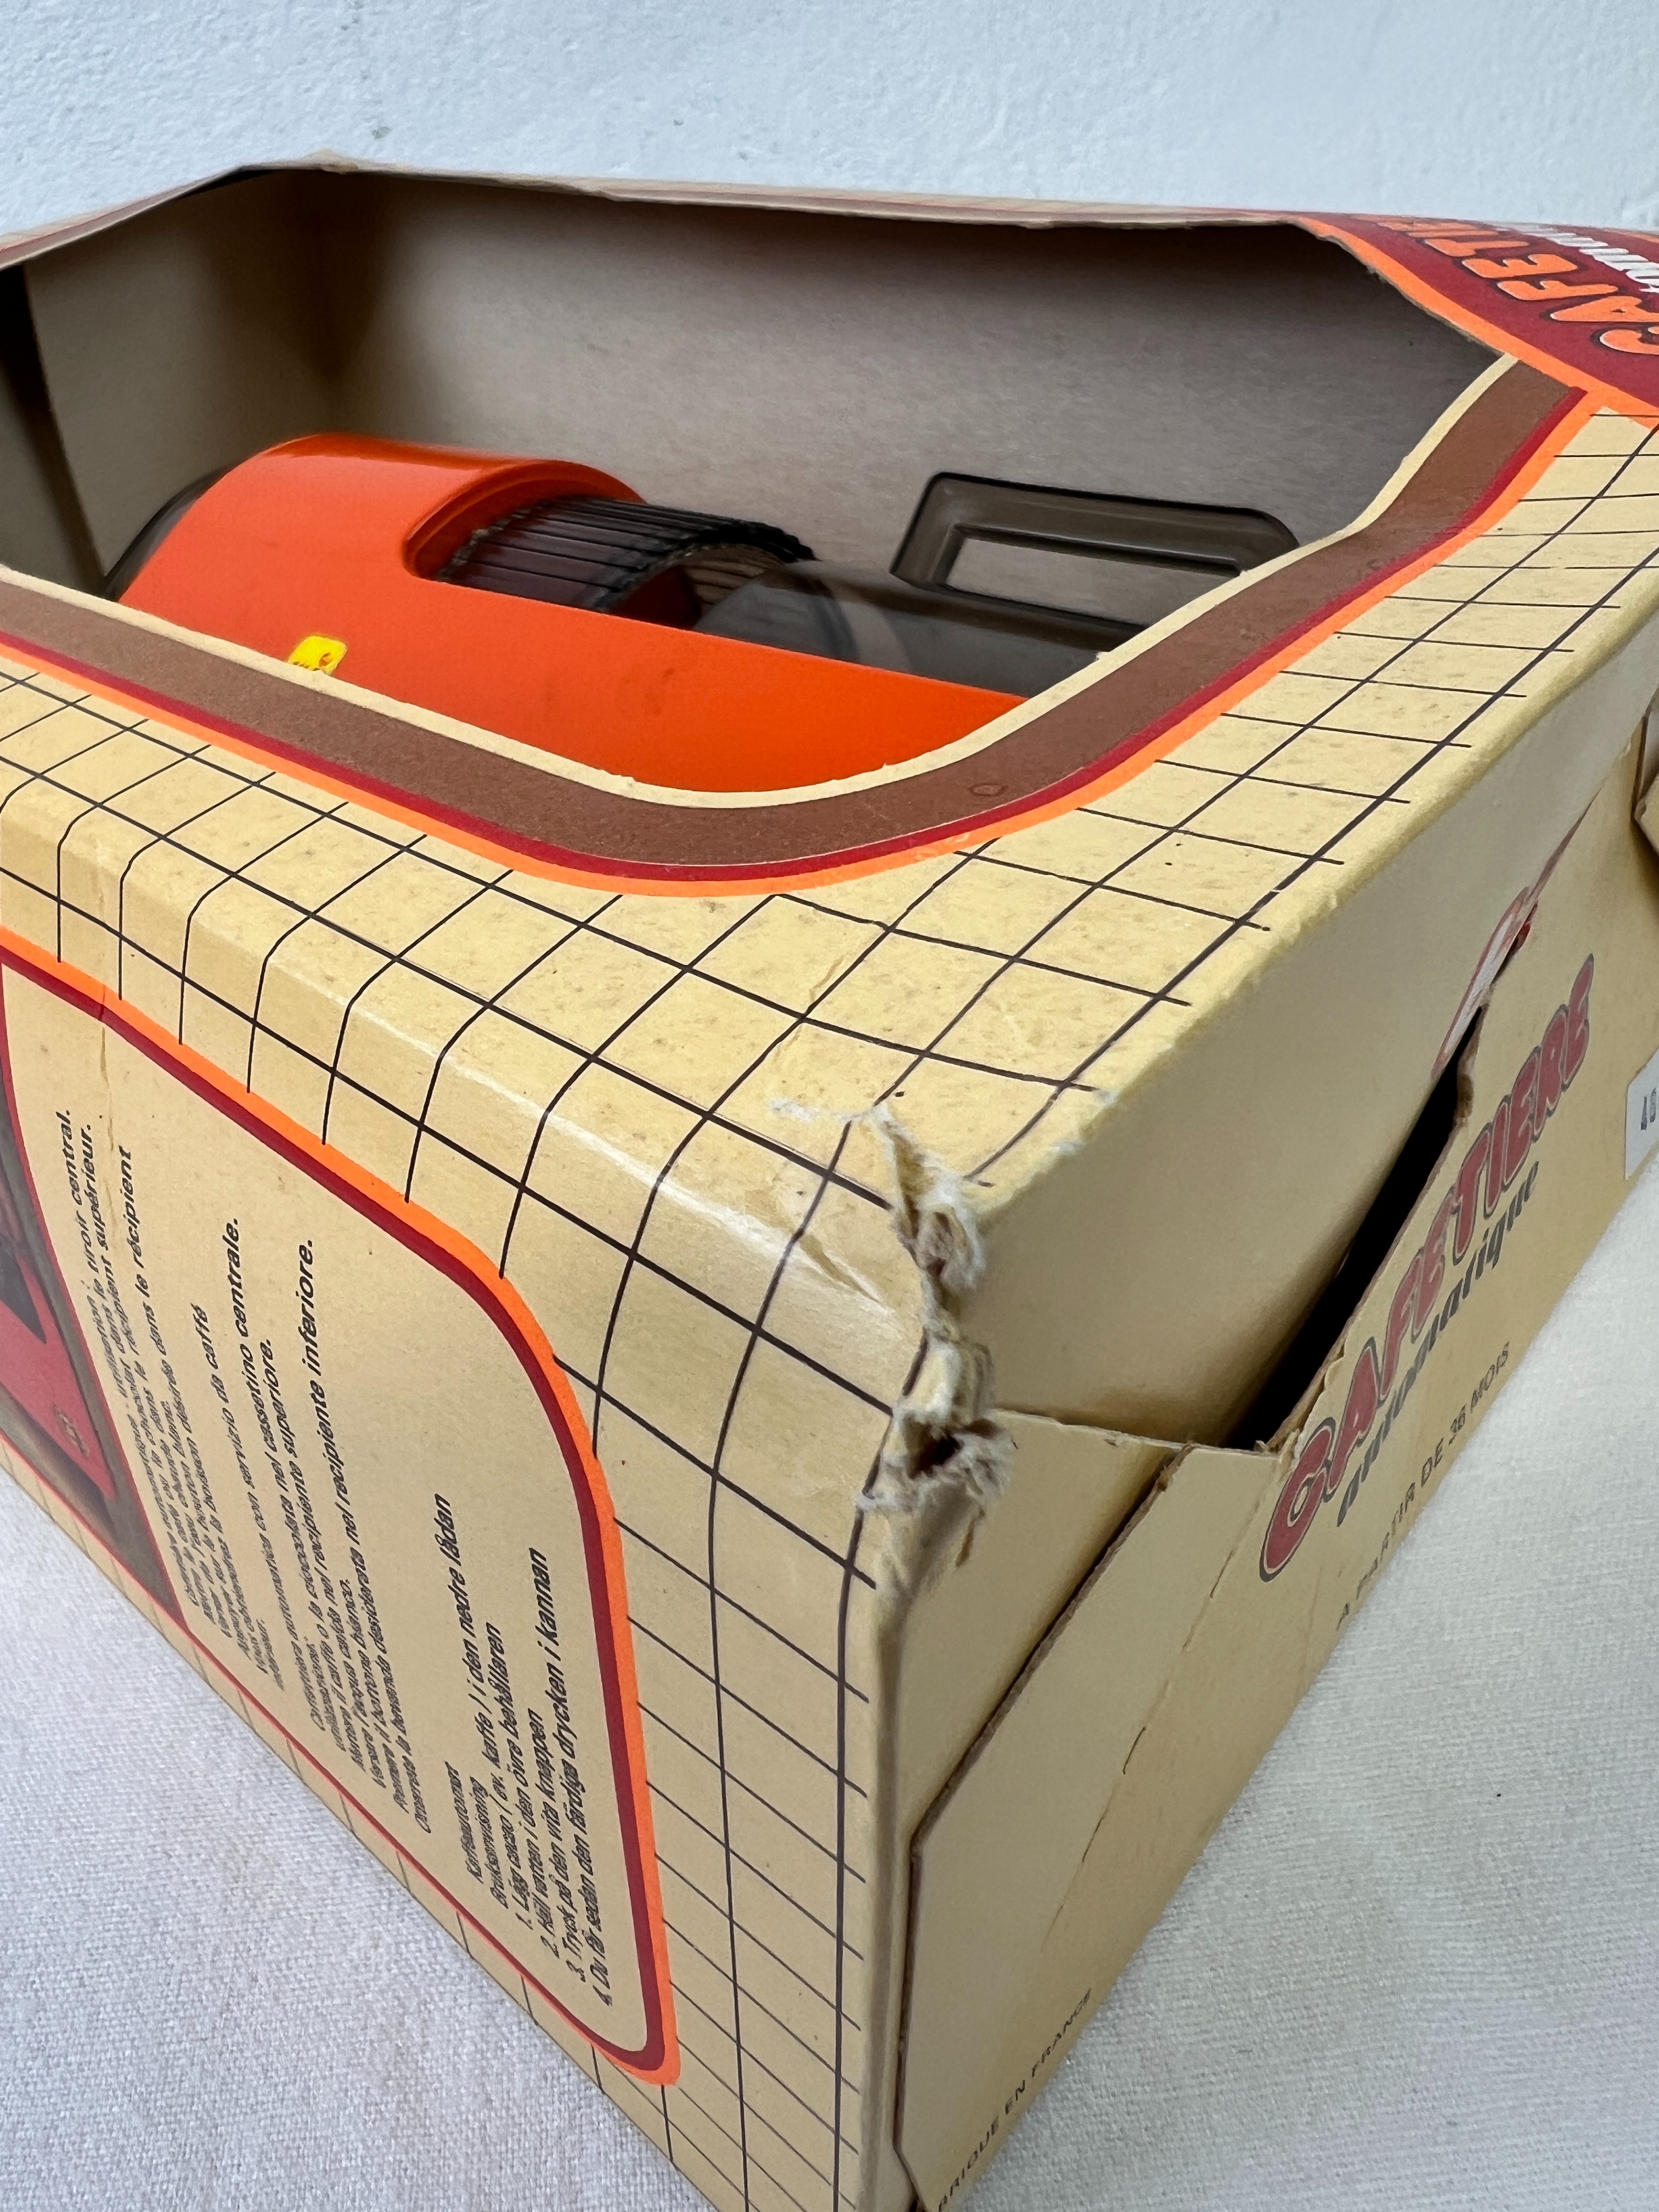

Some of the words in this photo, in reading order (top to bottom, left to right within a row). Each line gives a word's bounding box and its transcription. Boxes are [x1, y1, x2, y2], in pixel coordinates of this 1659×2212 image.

[57, 1109, 82, 1205] central.
[80, 1124, 109, 1251] supérieur.
[118, 1144, 144, 1269] récipient
[75, 1210, 99, 1274] tiroir
[1260, 953, 1593, 1581] CAFETIERE
[93, 1278, 107, 1301] le
[100, 1254, 139, 1356] récipient
[134, 1273, 150, 1298] le
[222, 1218, 249, 1338] centrale.
[101, 1303, 126, 1354] dans
[142, 1301, 166, 1356] dans
[297, 1239, 321, 1376] inferiore.
[134, 1360, 148, 1381] le
[1336, 1161, 1538, 1527] automatique
[119, 1357, 156, 1446] chocolat
[143, 1386, 165, 1434] dans
[161, 1358, 192, 1434] désirée
[210, 1373, 229, 1403] da
[239, 1343, 277, 1452] cassetino
[259, 1339, 297, 1458] superiore.
[1421, 1437, 1444, 1487] DE
[1470, 1341, 1509, 1413] MOIS
[160, 1401, 186, 1458] blanc.
[222, 1407, 255, 1489] servizio
[309, 1379, 350, 1505] recipiente
[186, 1436, 218, 1514] boisson
[264, 1451, 289, 1493] nel
[208, 1514, 223, 1534] la
[247, 1491, 267, 1531] con
[288, 1460, 328, 1571] recipiente
[334, 1501, 360, 1545] nel
[433, 1493, 461, 1566] lådan
[279, 1494, 318, 1600] cioccolata
[258, 1532, 299, 1641] automatica
[308, 1600, 325, 1623] la
[313, 1566, 337, 1606] nel
[338, 1578, 367, 1650] bianco.
[349, 1546, 387, 1654] desiderata
[447, 1566, 477, 1639] nedre
[528, 1547, 559, 1646] kannan
[315, 1623, 329, 1639] o
[326, 1606, 352, 1660] calda
[537, 1640, 561, 1662] i
[357, 1649, 388, 1728] bottone
[461, 1638, 484, 1684] den
[466, 1678, 487, 1697] i
[485, 1621, 520, 1740] behållaren
[330, 1683, 347, 1706] il
[374, 1654, 407, 1736] bevanda
[544, 1661, 578, 1759] drycken
[361, 1726, 387, 1788] Versare
[373, 1722, 392, 1743] il
[394, 1735, 412, 1756] la
[473, 1711, 501, 1770] kaffe
[527, 1707, 556, 1803] knappen
[490, 1772, 508, 1802] ev.
[506, 1737, 529, 1787] övre
[514, 1786, 536, 1827] den
[540, 1801, 562, 1842] vita
[558, 1758, 588, 1835] färdiga
[469, 1775, 509, 1909] Bruksanvisning
[499, 1814, 521, 1870] cacao
[517, 1820, 538, 1840] i
[571, 1833, 594, 1876] den
[507, 1866, 530, 1913] Lägg
[526, 1838, 548, 1899] vatten
[548, 1841, 569, 1882] den
[531, 1891, 556, 1938] Häll
[548, 1873, 578, 1914] på
[577, 1874, 602, 1932] sedan
[556, 1904, 583, 1961] Tryck
[589, 1956, 610, 1989] Du
[1005, 2079, 1025, 2115] EN
[1031, 1987, 1092, 2078] FRANCE
